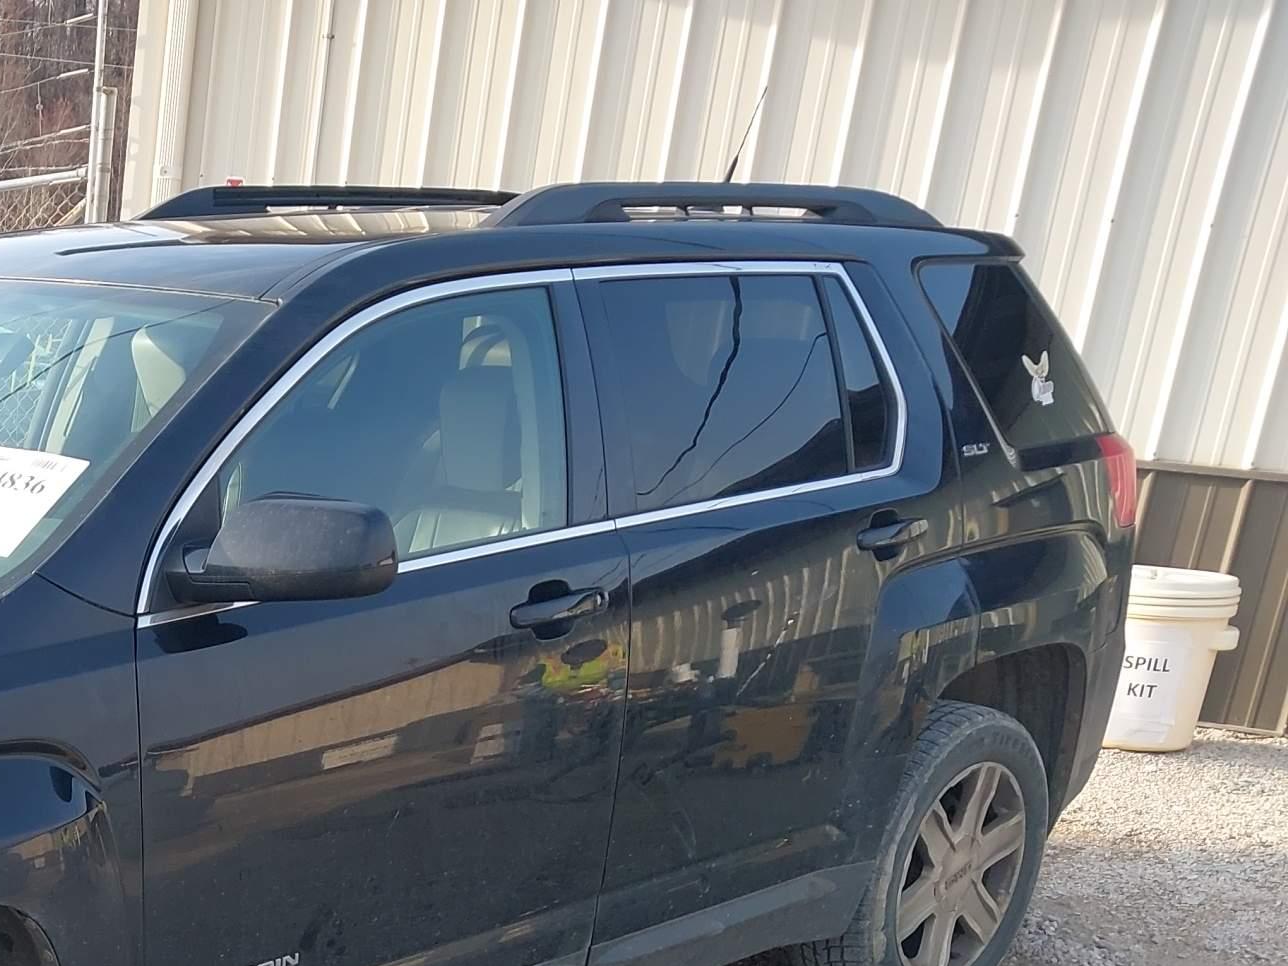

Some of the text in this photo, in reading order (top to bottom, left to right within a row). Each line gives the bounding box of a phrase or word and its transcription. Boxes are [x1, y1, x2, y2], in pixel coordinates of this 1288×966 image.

[962, 442, 990, 456] SLT
[1123, 655, 1170, 673] SPILL
[1127, 682, 1158, 698] KIT
